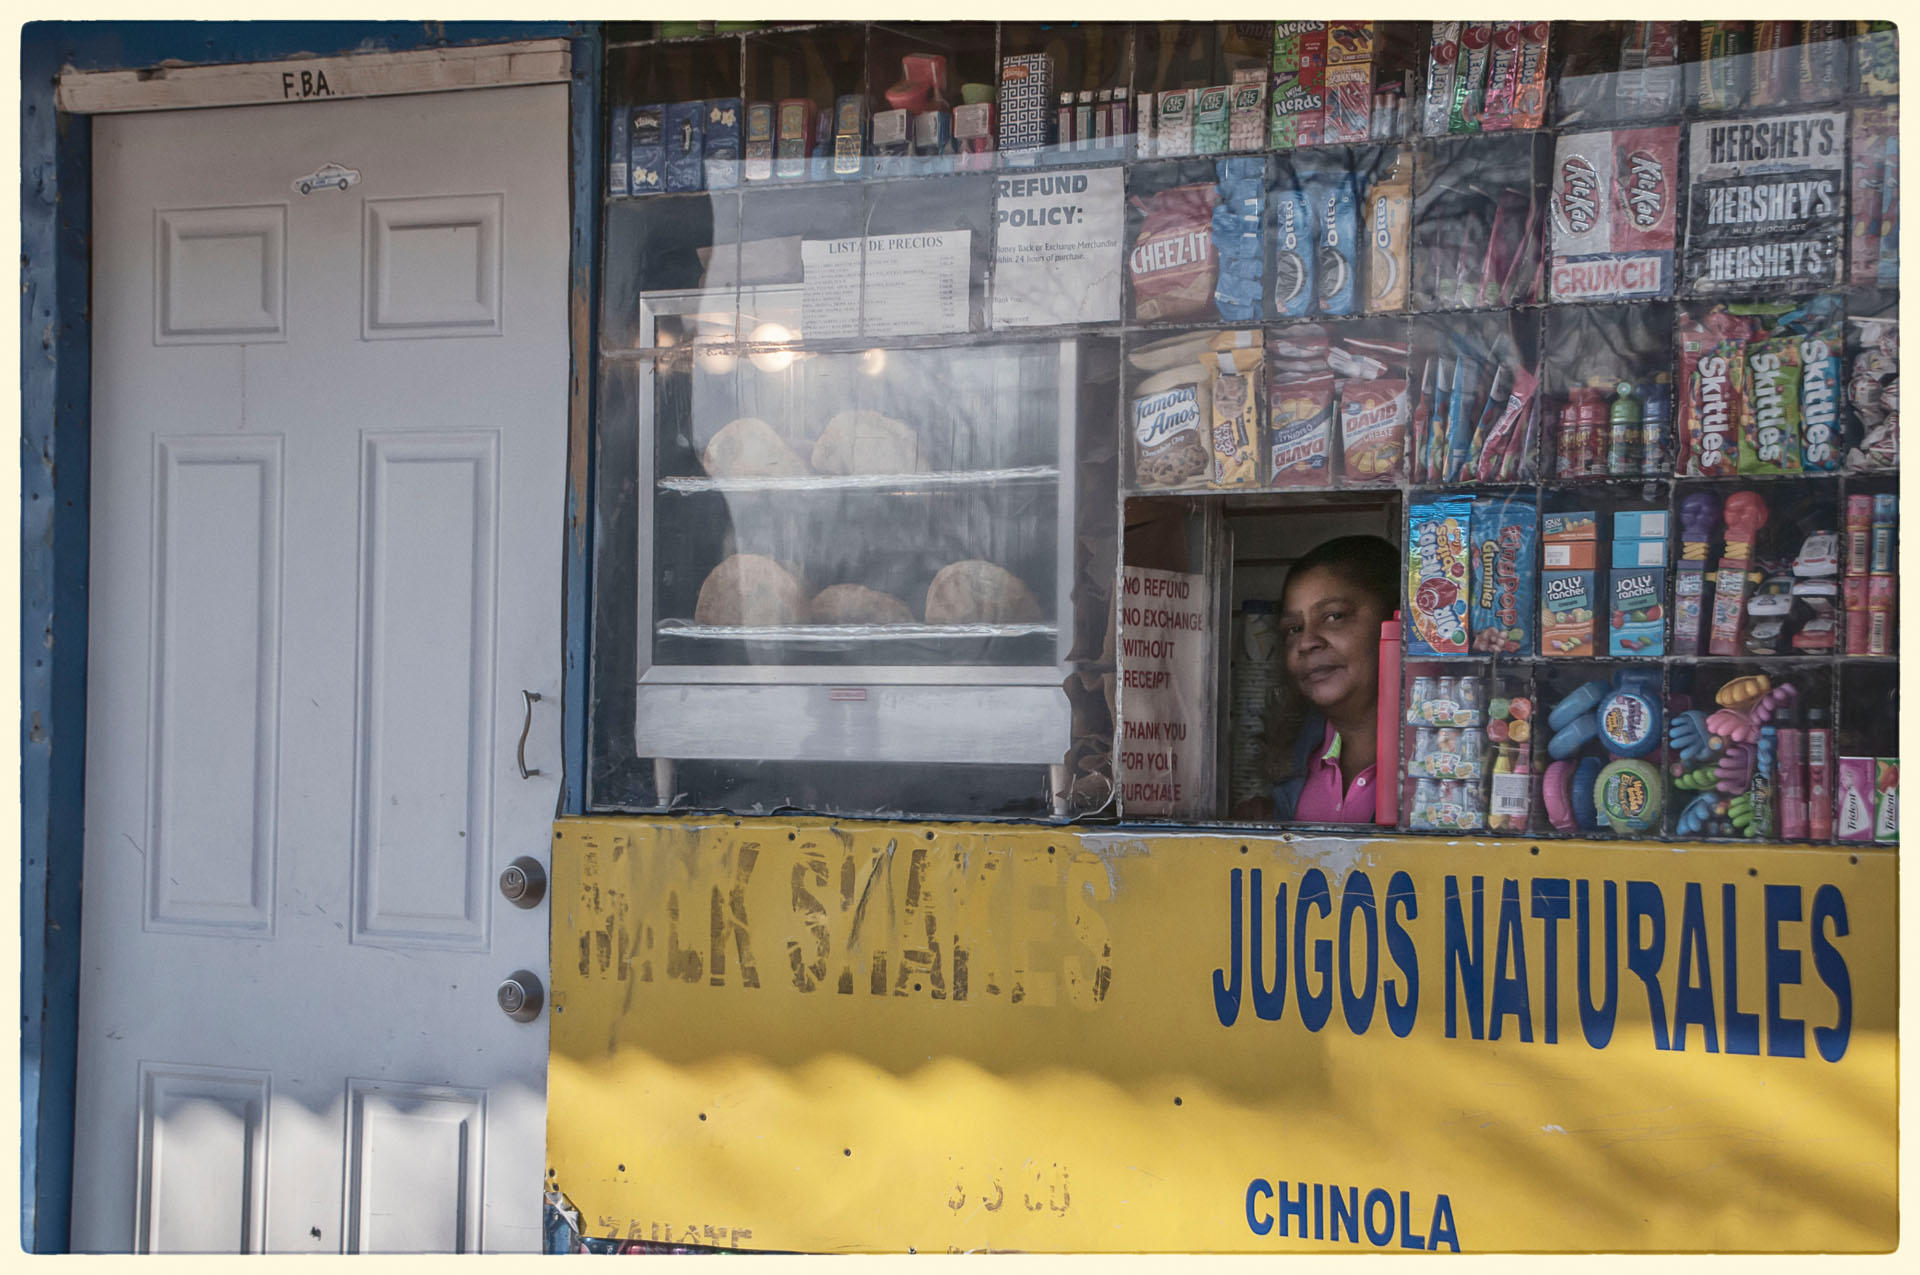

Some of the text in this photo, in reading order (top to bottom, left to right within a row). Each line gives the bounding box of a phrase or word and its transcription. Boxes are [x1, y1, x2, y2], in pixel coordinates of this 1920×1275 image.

[282, 70, 335, 98] F.B.A.
[1166, 103, 1182, 112] tac
[1710, 117, 1835, 164] HERSHEY'S
[998, 174, 1089, 198] REFUND
[998, 205, 1083, 228] POLICY:
[1708, 180, 1833, 225] HERSHEY'S
[1285, 200, 1297, 250] OREO
[1327, 196, 1339, 247] OREO
[1376, 196, 1391, 248] OREO
[1732, 223, 1807, 234] MILK CHOCOLATE
[869, 240, 885, 251] DE
[888, 235, 944, 250] PRECIOS
[1045, 242, 1076, 252] Exchange
[1130, 231, 1208, 274] CHEEZ-IT
[1015, 255, 1024, 263] 24
[1708, 240, 1824, 281] HERSHEY'S
[1553, 261, 1657, 295] CRUNCH
[1135, 386, 1197, 426] Famous
[1698, 356, 1729, 467] Skittles
[1751, 352, 1785, 462] Skittles
[1801, 339, 1836, 463] Skittles
[1143, 406, 1197, 442] Amos
[1345, 403, 1398, 433] DAVID
[1275, 438, 1324, 469] DAVID
[1122, 576, 1190, 600] NO REFUND
[1547, 576, 1582, 594] JOLLY
[1549, 586, 1585, 601] rancher
[1616, 575, 1652, 593] JOLLY
[1618, 586, 1655, 600] rancher
[1122, 607, 1203, 632] NO EXCHANGE
[1122, 638, 1175, 659] WITHOUT
[1124, 669, 1171, 689] RECEIPT
[1123, 720, 1187, 741] THANK YOU
[1121, 751, 1178, 771] FOR YOUR
[1212, 867, 1853, 1063] JUGOS NATURALES
[1245, 1177, 1461, 1254] CHINOLA
